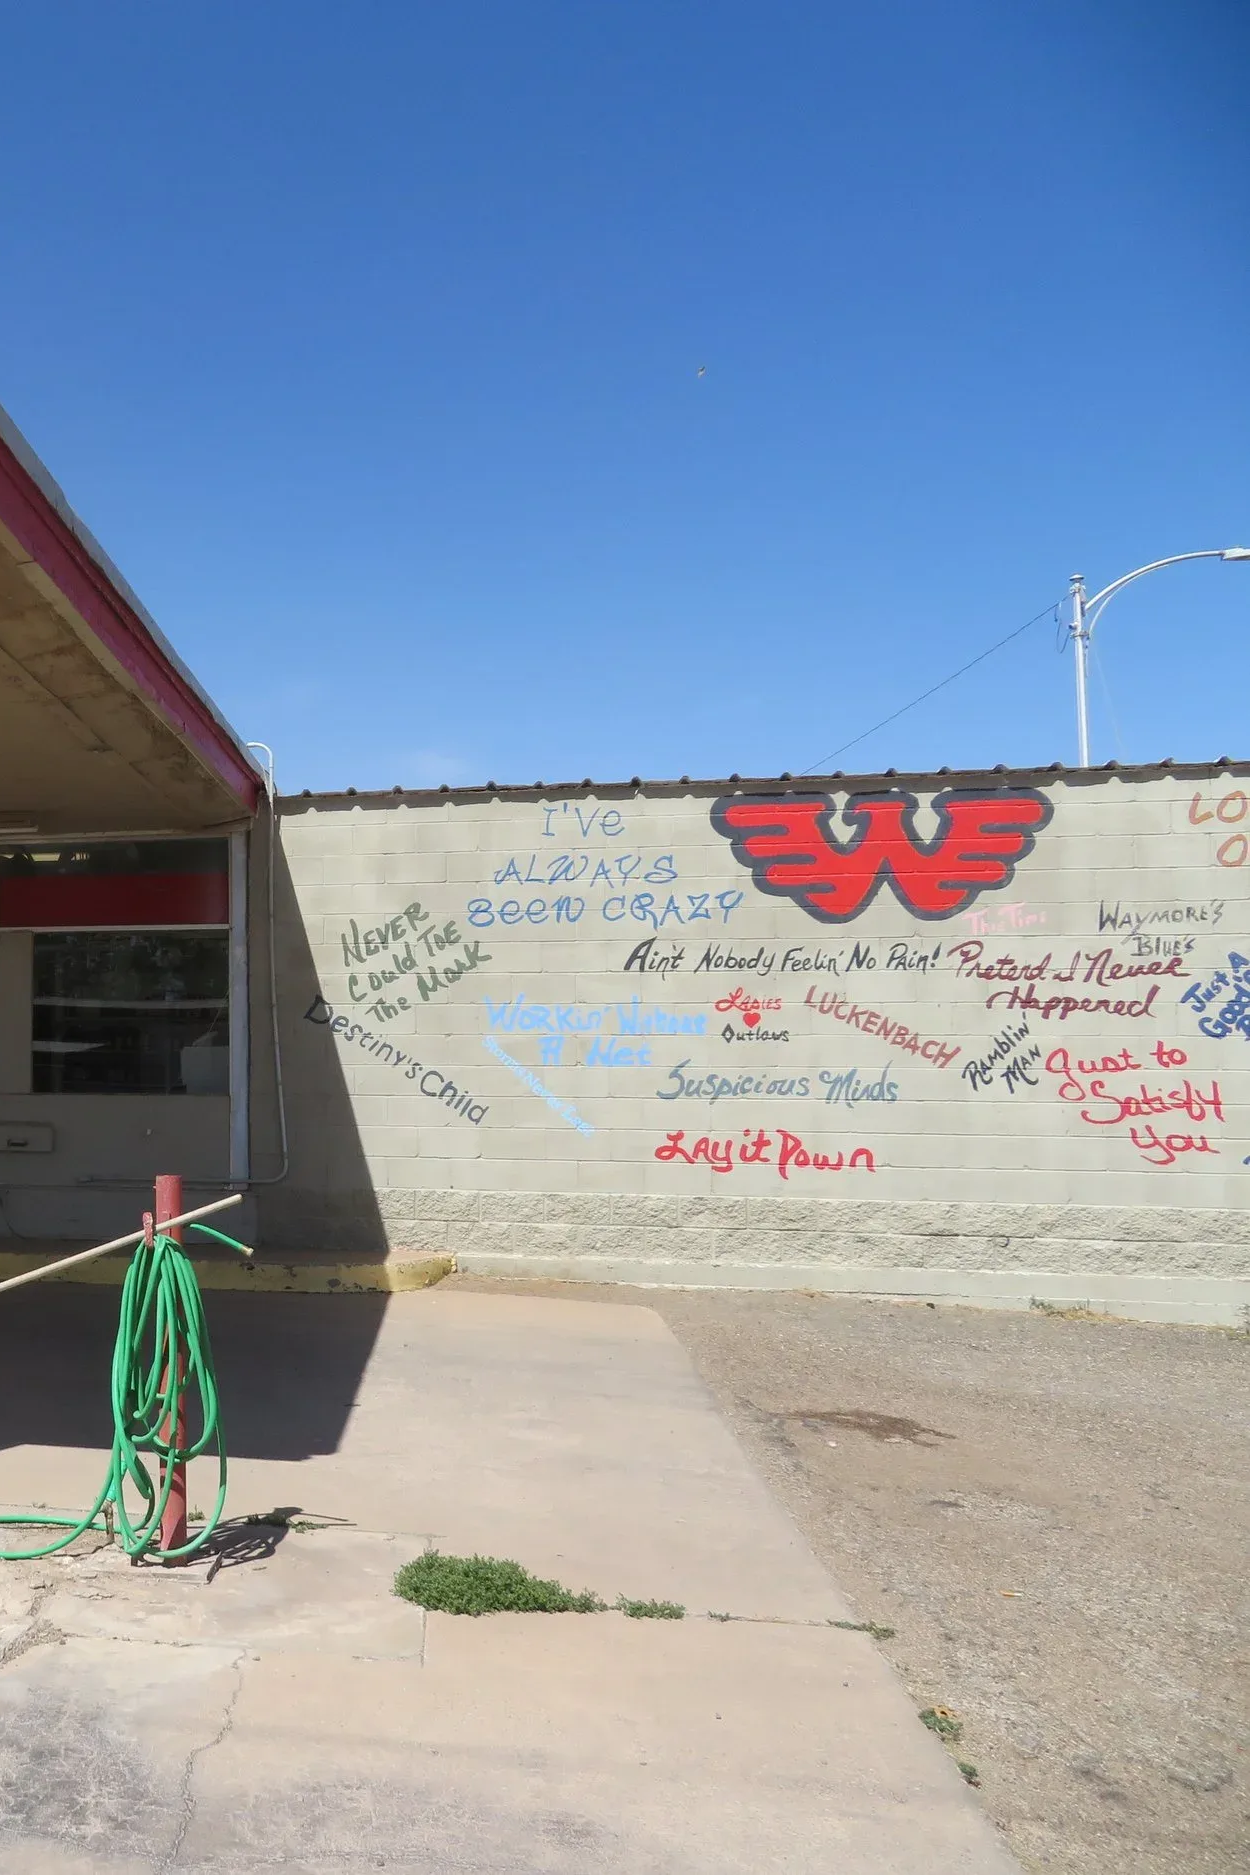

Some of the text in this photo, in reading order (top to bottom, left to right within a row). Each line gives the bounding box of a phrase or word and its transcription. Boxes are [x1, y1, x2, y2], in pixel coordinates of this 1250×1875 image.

[494, 854, 679, 888] ALWAYS
[341, 902, 430, 967] NEVER
[602, 890, 744, 932] CRAZY
[623, 936, 685, 981] Ain't
[694, 942, 777, 976] Nobody
[781, 946, 844, 977] Feelin'
[845, 941, 876, 972] No
[365, 997, 411, 1023] The
[986, 983, 1161, 1020] Happened
[804, 984, 962, 1068] LUCKENBACH
[303, 994, 489, 1125] Destiny's Child
[1000, 1044, 1041, 1094] MAN
[1150, 1040, 1187, 1068] to
[656, 1058, 899, 1108] Suspicious Minds
[739, 1128, 772, 1163] it
[776, 1129, 876, 1180] Down
